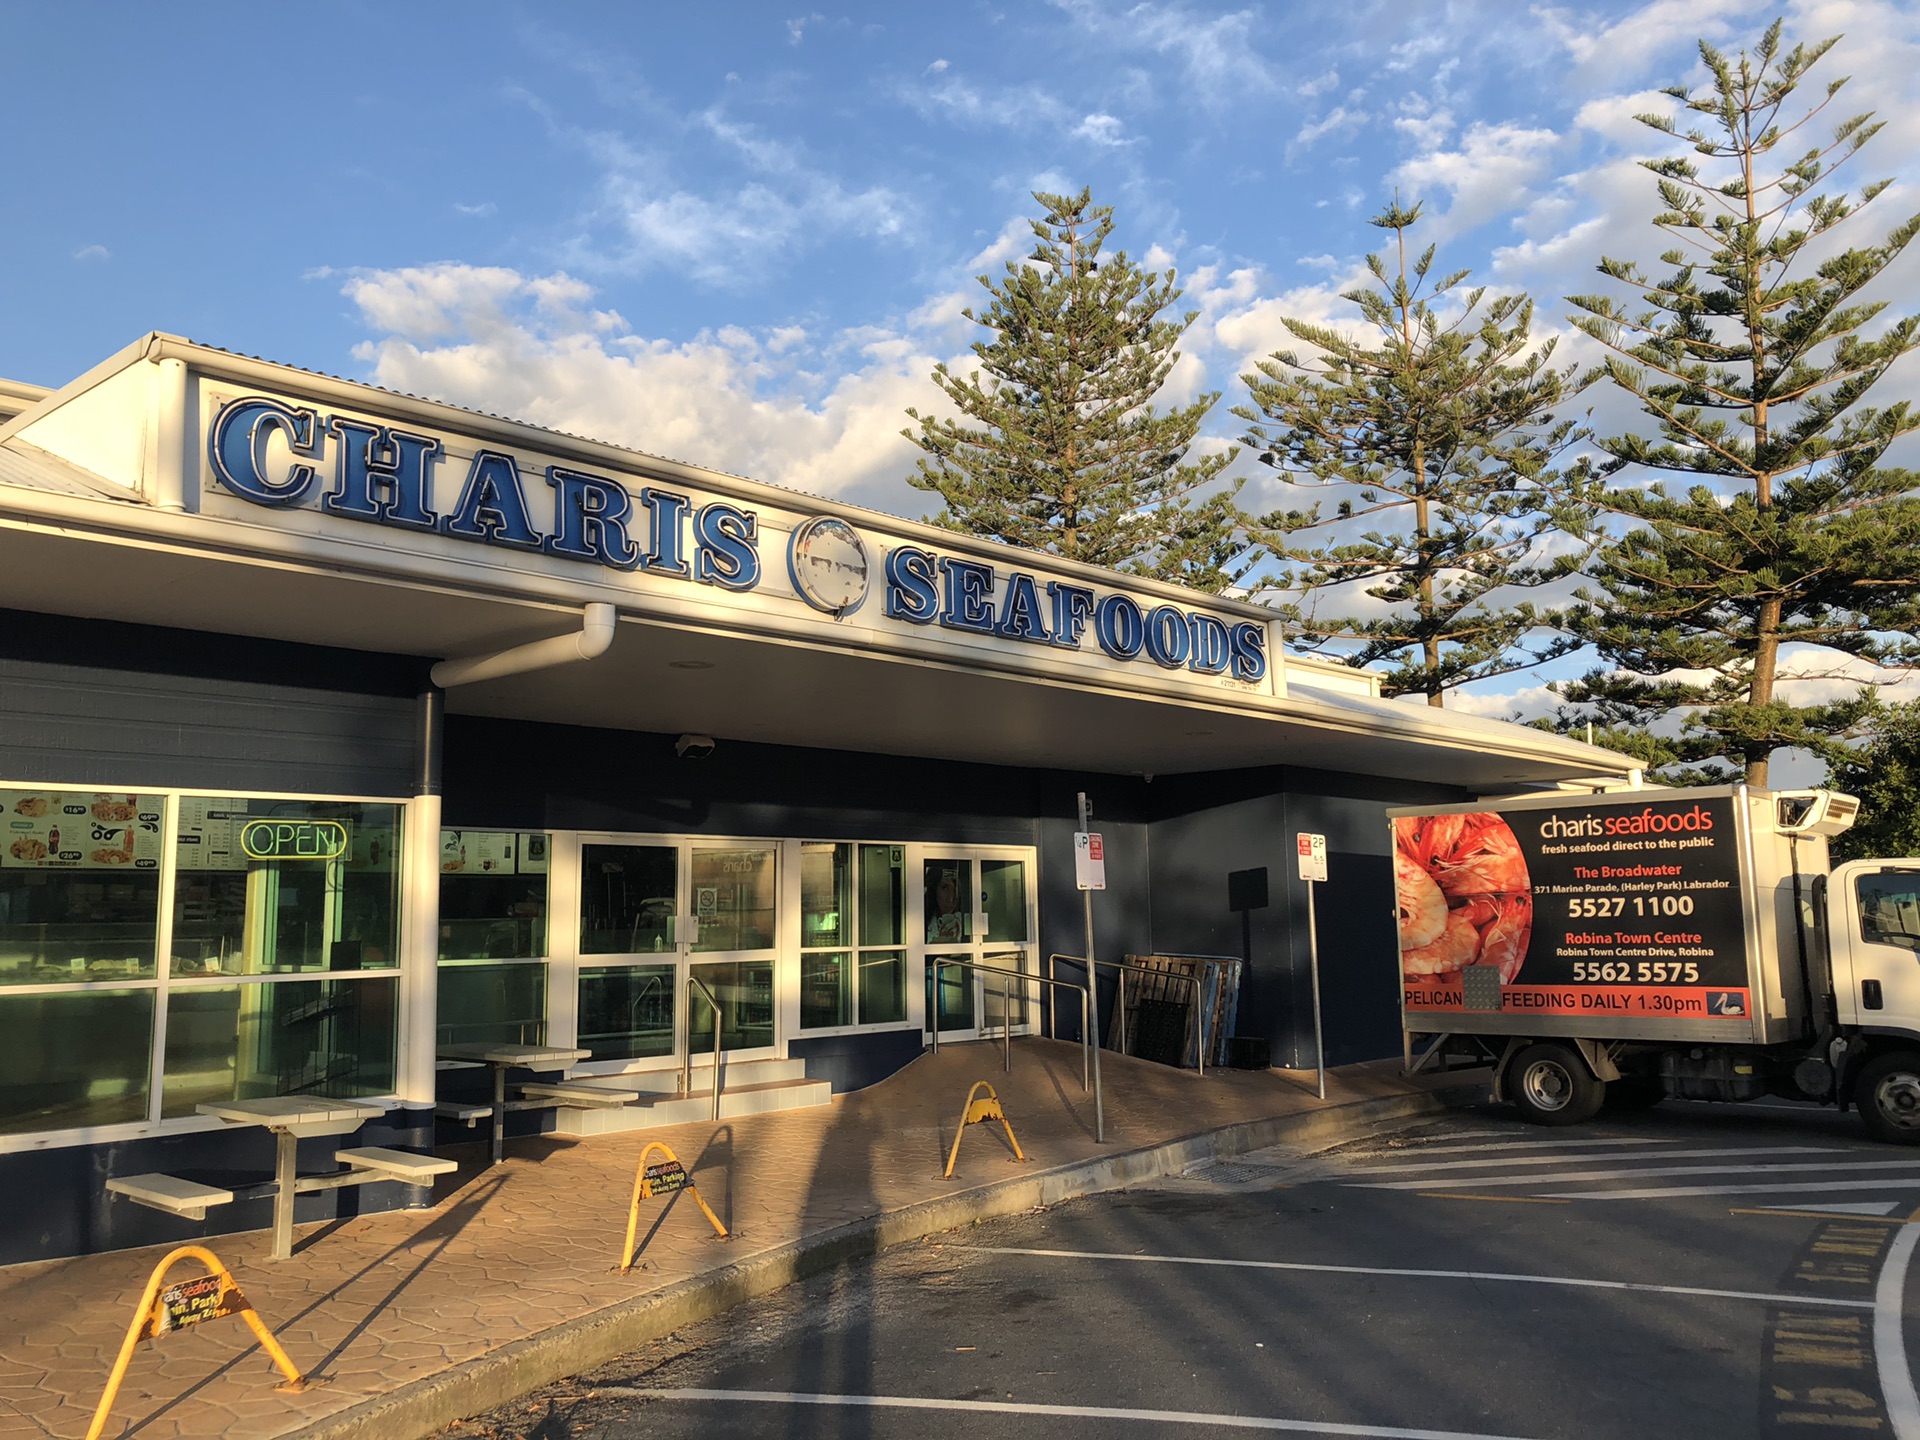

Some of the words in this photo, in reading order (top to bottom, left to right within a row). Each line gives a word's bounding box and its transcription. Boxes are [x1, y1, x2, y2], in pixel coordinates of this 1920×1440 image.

[209, 395, 761, 591] CHARIS
[885, 545, 1268, 682] SEAFOODS
[250, 824, 336, 855] OPEN
[1313, 837, 1324, 848] 2P
[1542, 844, 1567, 854] fresh
[1569, 842, 1610, 853] seafood
[1612, 840, 1643, 851] direct
[1645, 840, 1656, 849] to
[1658, 838, 1677, 849] the
[1680, 836, 1714, 850] public
[1574, 866, 1599, 879] The
[1601, 864, 1682, 878] Broadwater
[1534, 885, 1550, 894] 371
[1552, 884, 1584, 893] Marine
[1585, 883, 1619, 893] Parade,
[1621, 882, 1655, 892] (Harley
[1656, 880, 1682, 891] Park)
[1684, 879, 1730, 889] Labrador
[1569, 897, 1625, 918] 5527
[1633, 895, 1694, 916] 1100
[1565, 932, 1613, 944] Robina
[1614, 932, 1651, 944] Town
[1654, 931, 1702, 944] Centre
[1556, 947, 1588, 957] Robina
[1589, 947, 1614, 956] Town
[1615, 947, 1647, 956] Centre
[1648, 947, 1677, 957] Drive,
[1678, 947, 1714, 956] Robina
[1573, 962, 1631, 982] 5562
[1638, 962, 1699, 983] 5575
[1405, 990, 1462, 1006] PELICAN
[1502, 992, 1576, 1008] FEEDING
[1581, 993, 1632, 1009] DAILY
[1637, 995, 1702, 1014] 1.30pm
